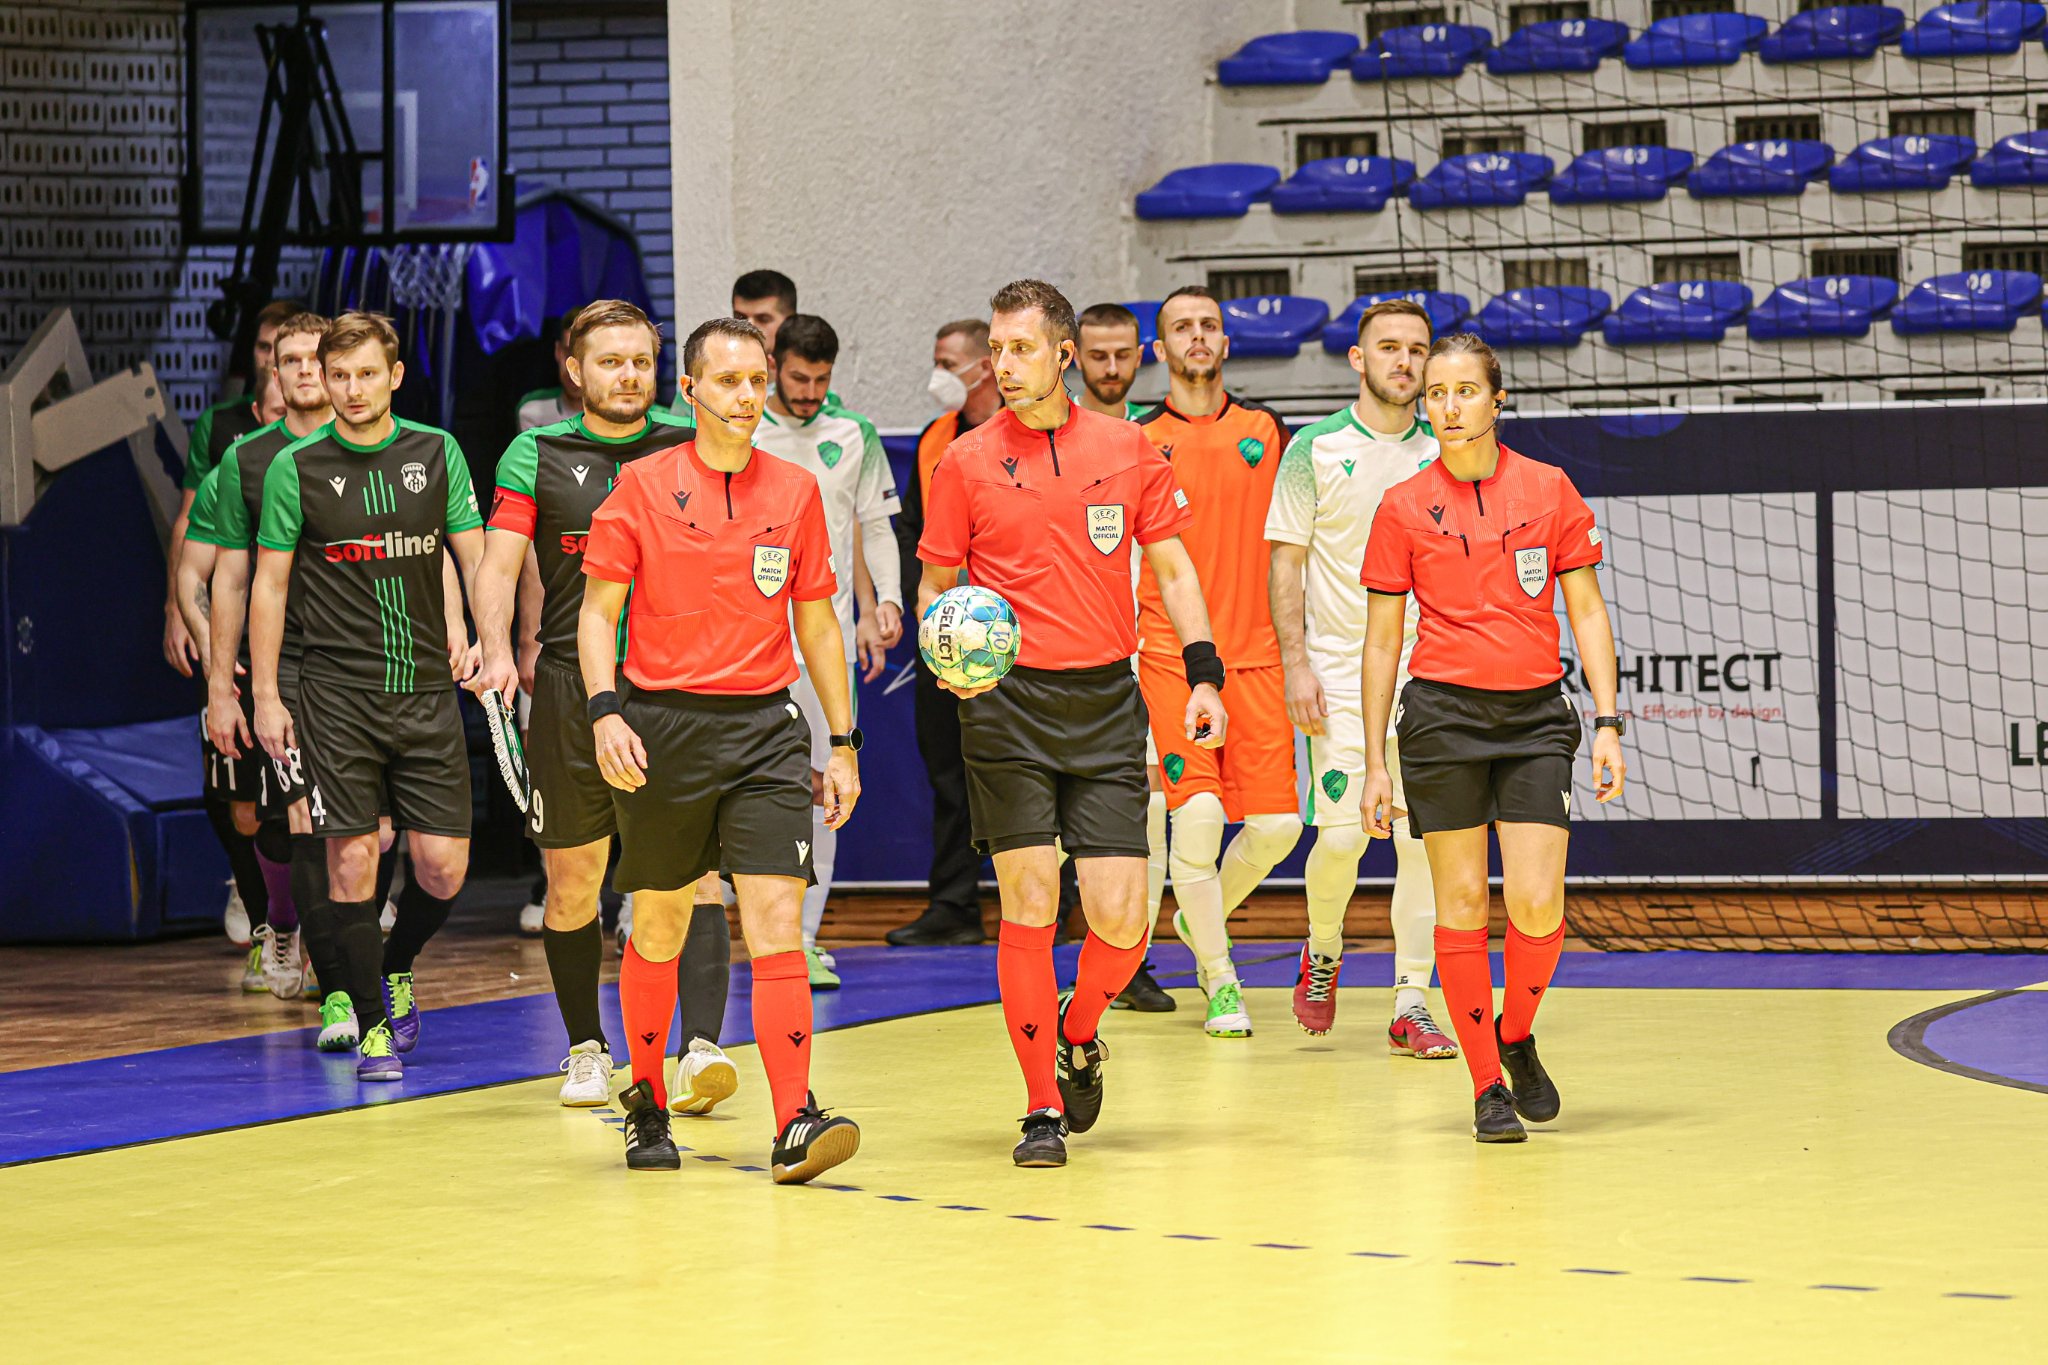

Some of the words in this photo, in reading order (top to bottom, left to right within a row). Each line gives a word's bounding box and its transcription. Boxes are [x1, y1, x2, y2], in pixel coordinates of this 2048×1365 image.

[1422, 25, 1446, 42] 01
[1560, 20, 1586, 37] 02
[1345, 157, 1370, 175] 01
[1257, 298, 1282, 315] 01
[1093, 510, 1117, 520] UEFA
[761, 552, 784, 562] UEFA
[1522, 554, 1542, 564] UEFA
[757, 574, 783, 583] OFFICIAL
[760, 567, 782, 575] MATCH
[1521, 575, 1545, 584] OFFICIAL
[938, 605, 955, 662] SELECT
[1560, 653, 1782, 693] RHITECT
[1708, 704, 1725, 721] by
[311, 784, 327, 825] 4
[531, 788, 544, 834] 9
